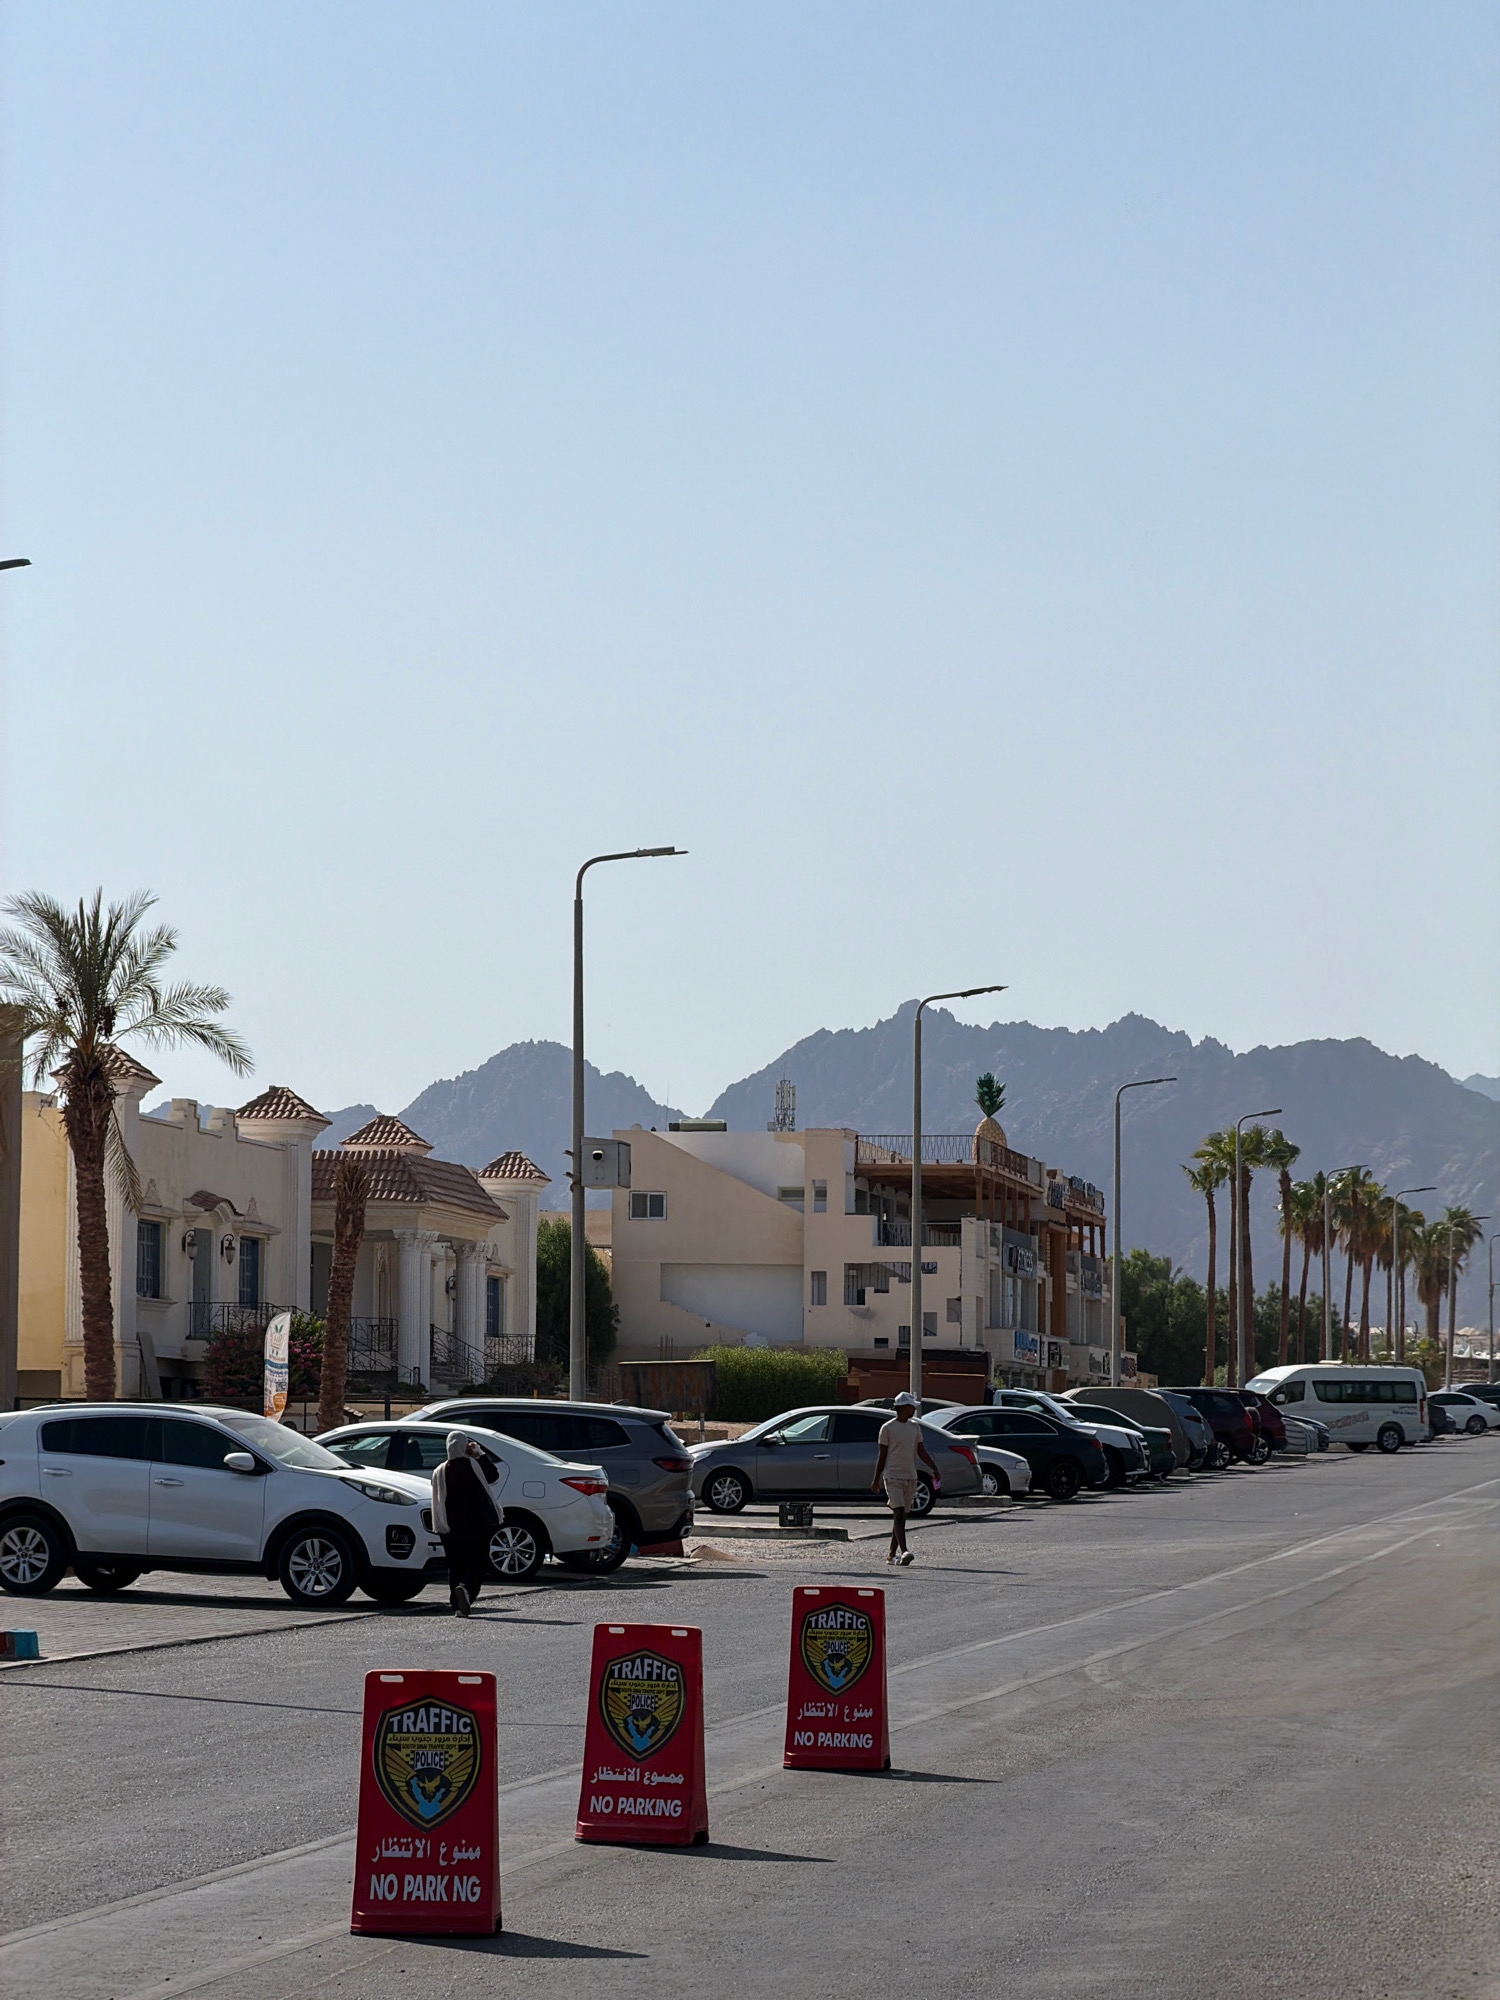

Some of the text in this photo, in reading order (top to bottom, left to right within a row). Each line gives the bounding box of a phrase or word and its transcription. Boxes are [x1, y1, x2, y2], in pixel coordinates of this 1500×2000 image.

[808, 1610, 866, 1629] TRAFFIC
[827, 1641, 848, 1654] POLICE
[611, 1658, 678, 1681] TRAFFIC
[631, 1695, 655, 1710] POLICE
[796, 1702, 873, 1723] ممنوع الانتظار
[389, 1707, 472, 1733] TRAFFIC
[794, 1731, 874, 1749] NO PARKING
[415, 1751, 444, 1769] POLICE
[590, 1766, 640, 1784] الانتظار
[589, 1795, 683, 1817] NO PARKING
[371, 1836, 482, 1867] ممنوع الانتظار
[369, 1873, 399, 1901] NO
